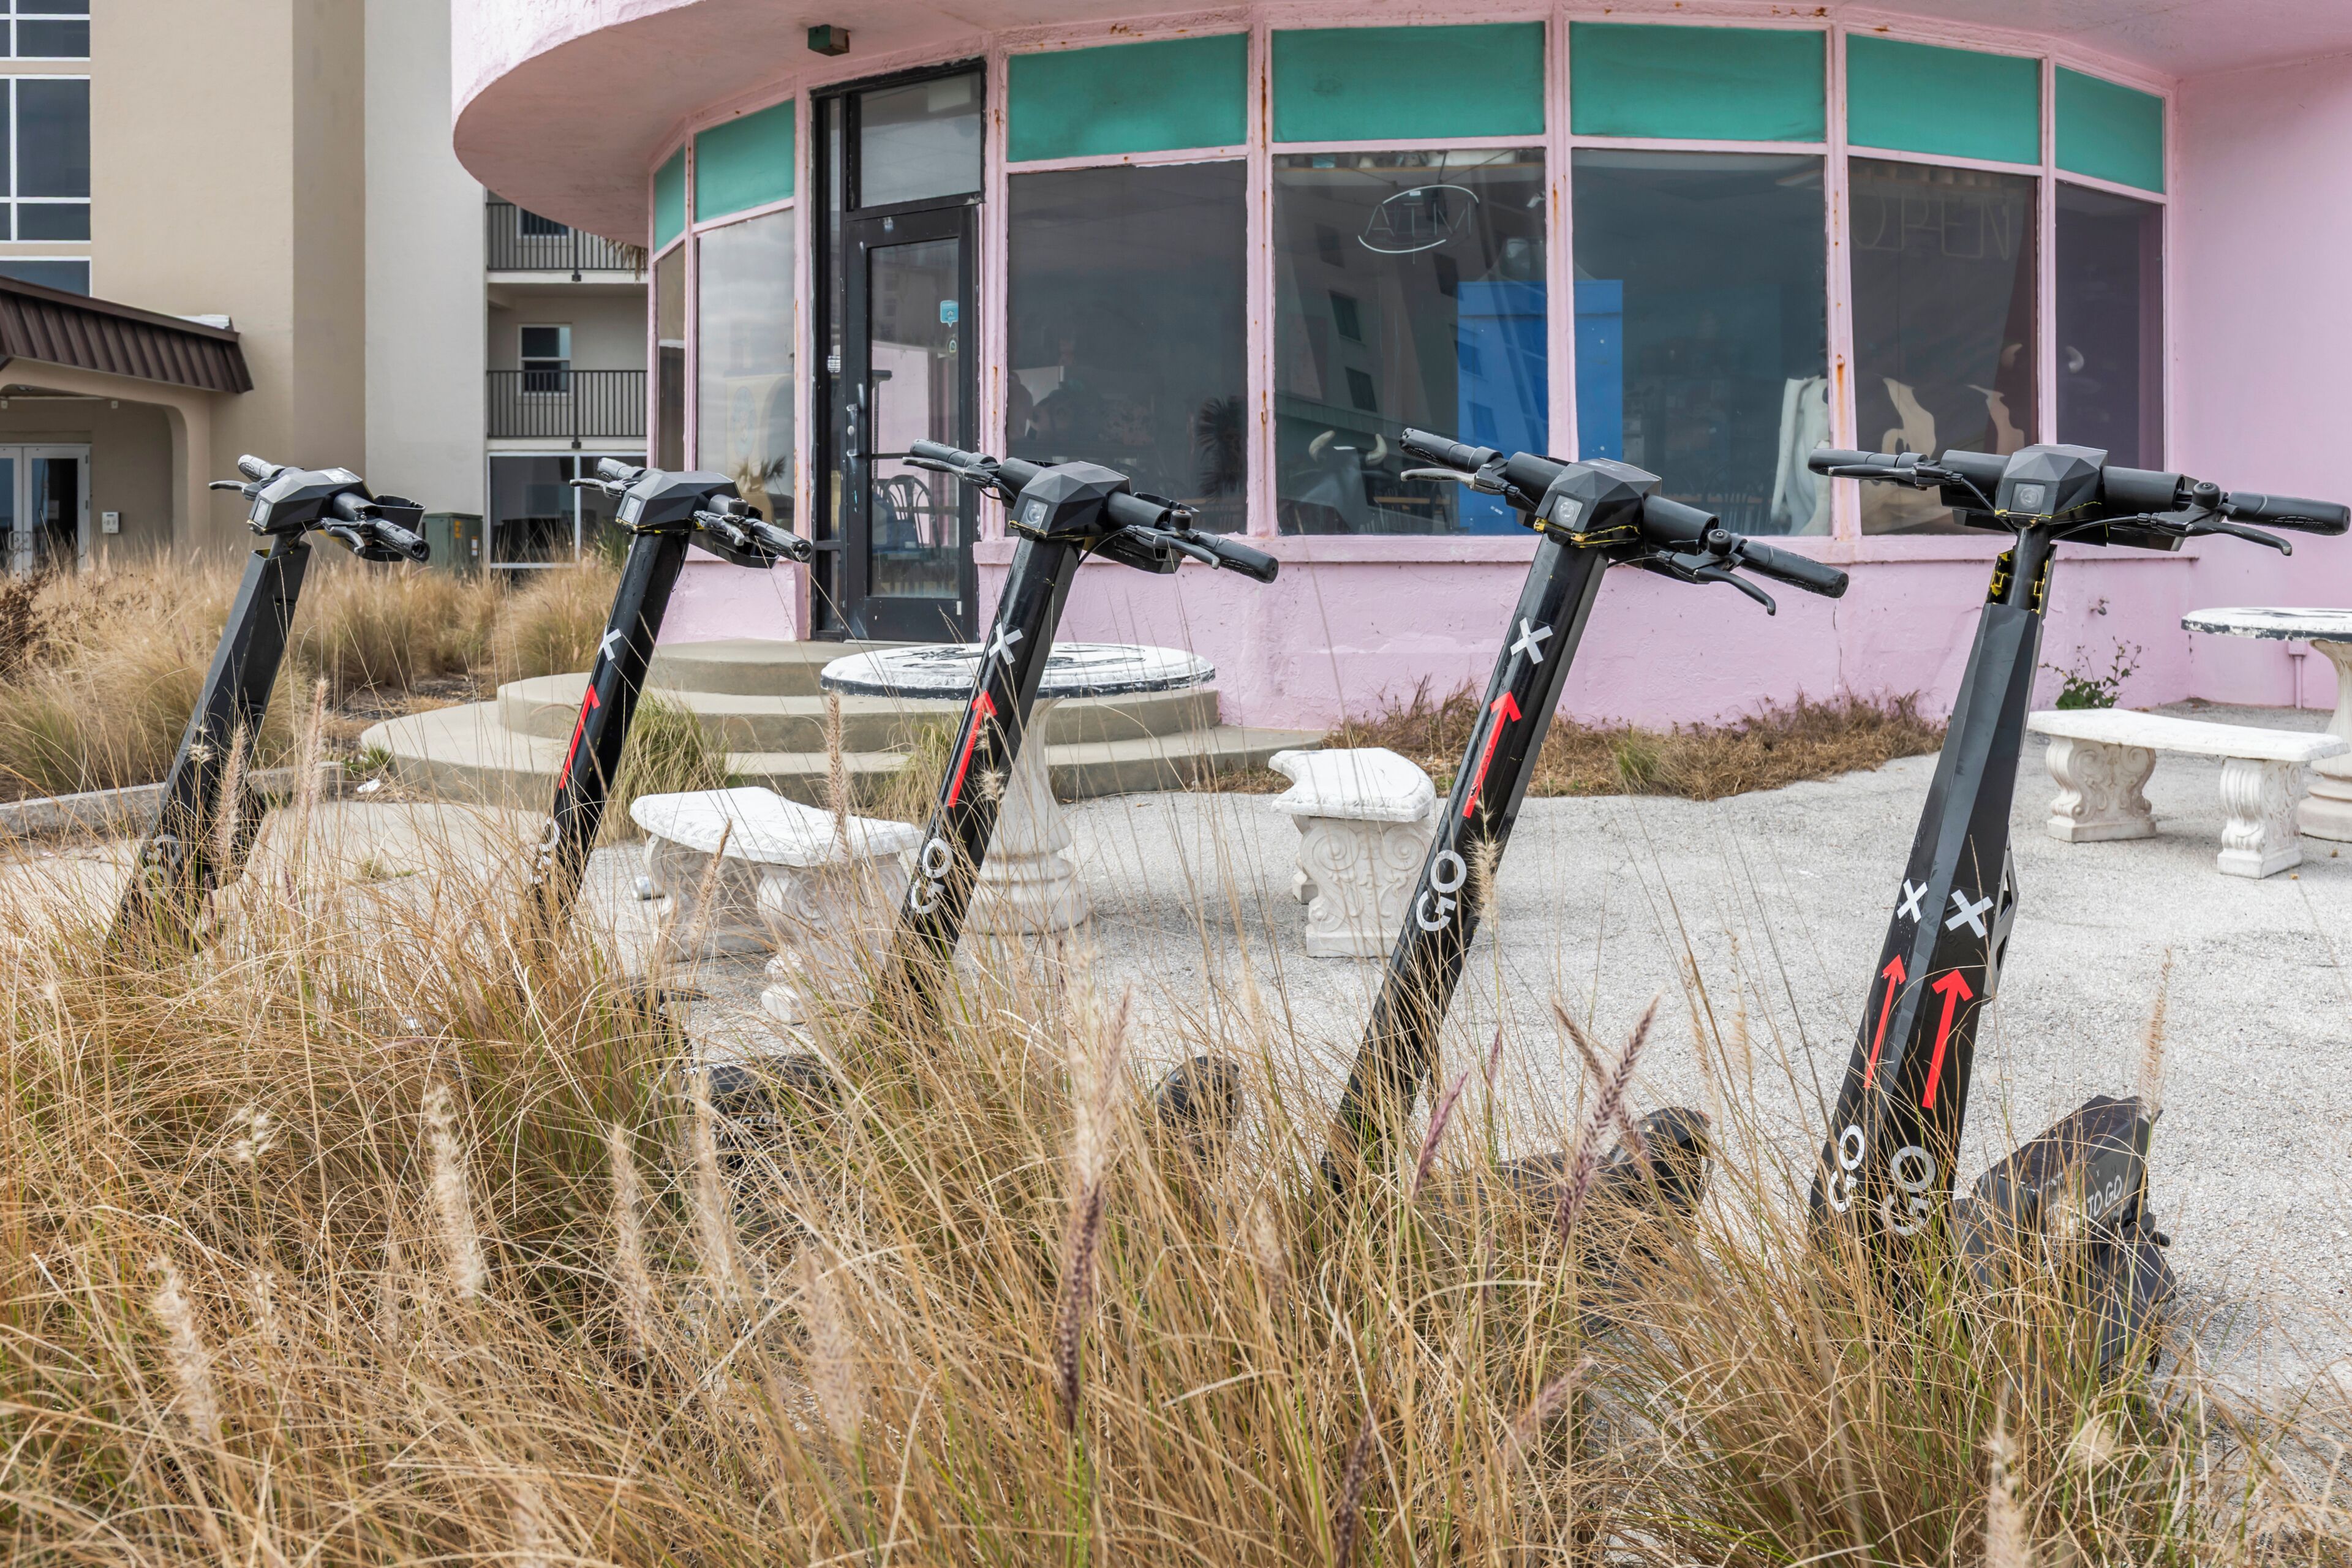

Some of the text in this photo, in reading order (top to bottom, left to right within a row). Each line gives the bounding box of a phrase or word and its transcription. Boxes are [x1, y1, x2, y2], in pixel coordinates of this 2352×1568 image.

[1363, 200, 1472, 238] ATM
[1850, 189, 2010, 261] OPEN
[911, 837, 953, 914] GO
[1415, 849, 1467, 932] GO
[1828, 1125, 1865, 1213] GO
[1880, 1145, 1936, 1237] GO
[2105, 1174, 2123, 1208] GO
